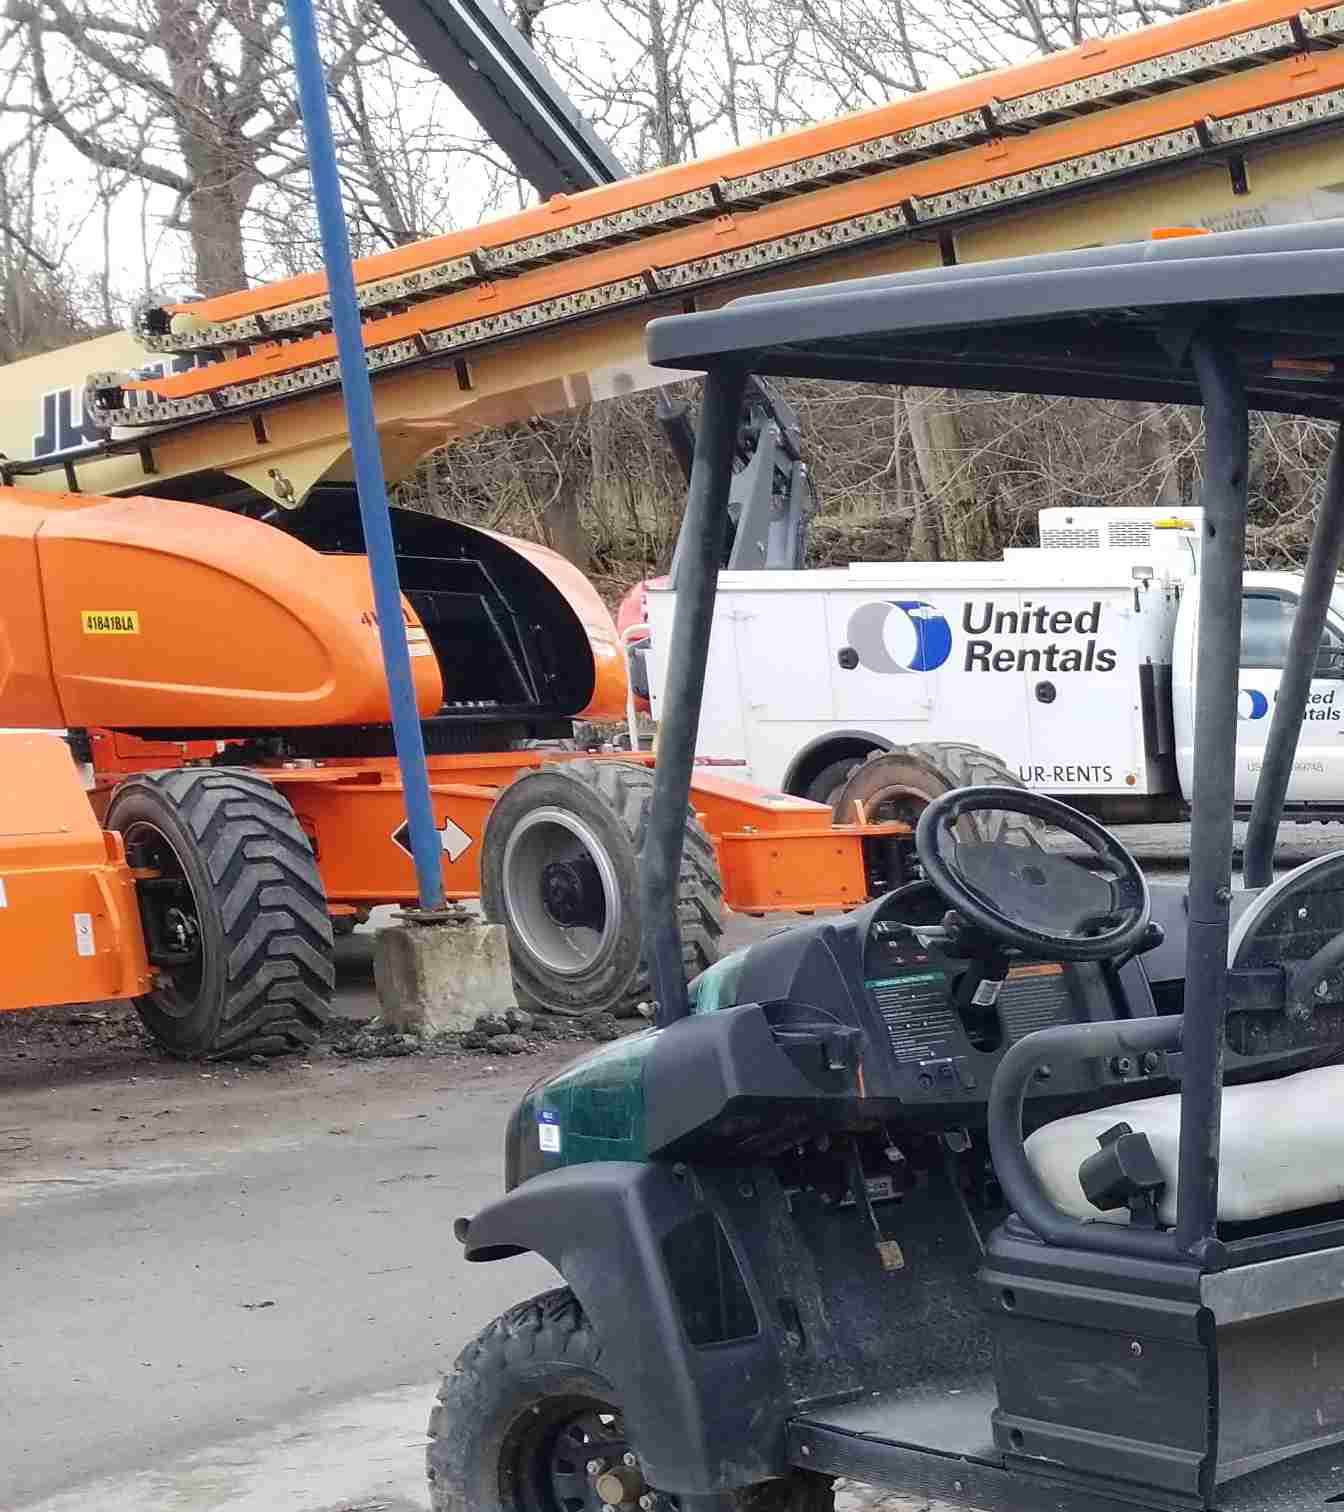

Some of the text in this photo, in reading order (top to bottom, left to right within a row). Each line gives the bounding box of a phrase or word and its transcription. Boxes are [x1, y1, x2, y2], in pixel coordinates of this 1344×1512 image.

[961, 601, 1102, 635] United
[964, 639, 1117, 673] Rentals
[1019, 766, 1112, 783] UR-RENTS
